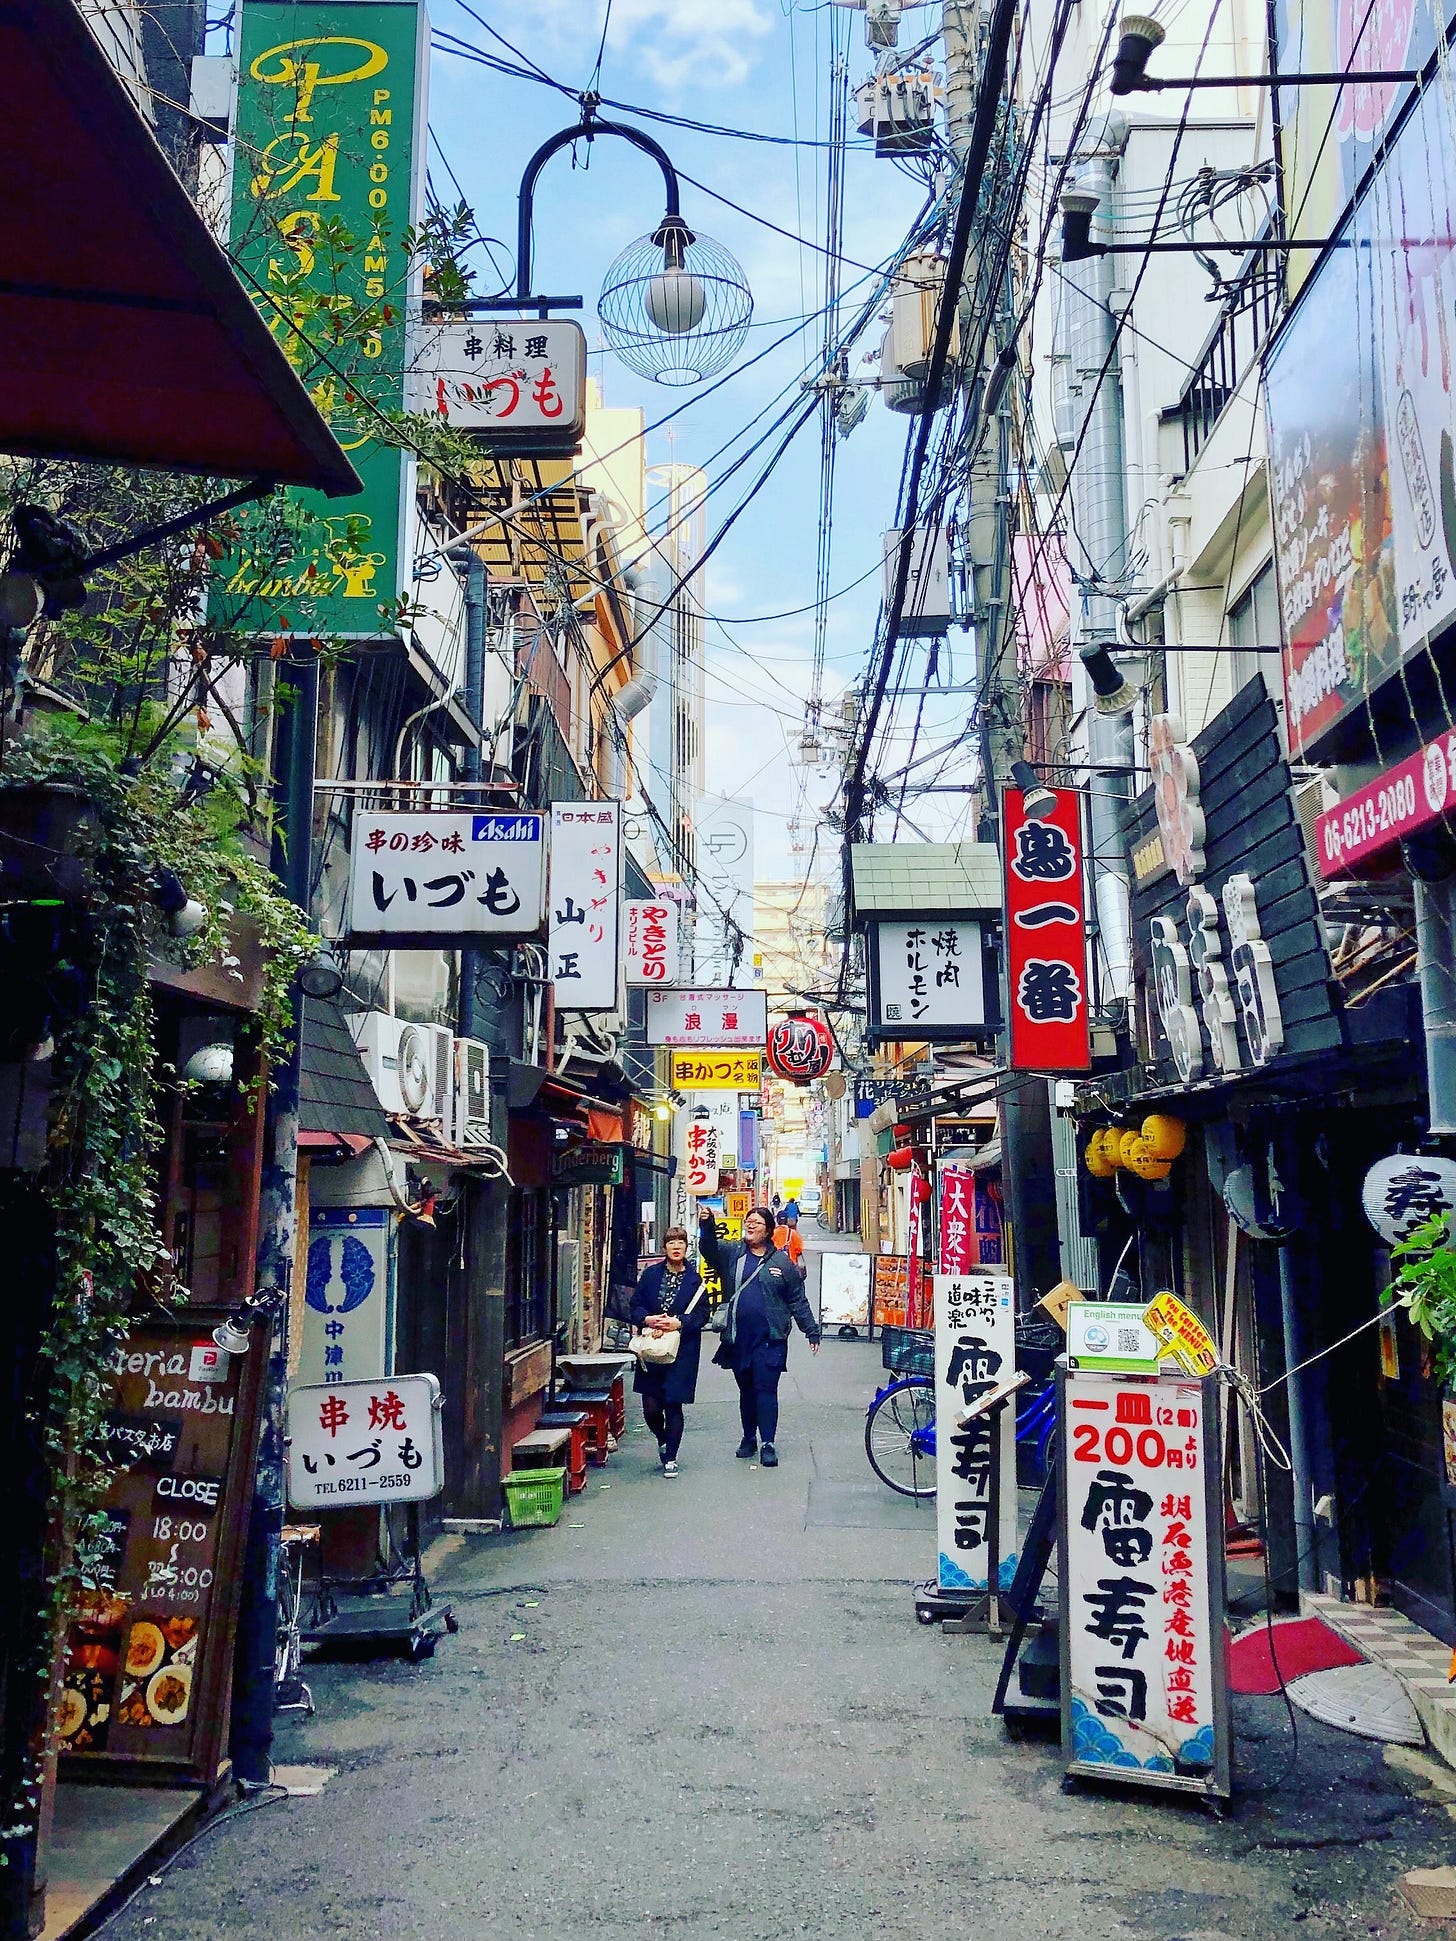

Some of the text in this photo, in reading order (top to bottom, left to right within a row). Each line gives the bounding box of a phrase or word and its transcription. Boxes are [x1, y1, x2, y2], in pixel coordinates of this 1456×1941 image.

[463, 335, 549, 361] 串料理
[436, 367, 566, 420] いづも
[477, 817, 535, 841] Asahi
[561, 811, 614, 825] 日本盛
[364, 829, 466, 855] 串の珍味
[372, 866, 521, 917] いづも
[555, 896, 585, 980] 山正
[628, 907, 639, 956] キリンビール
[642, 906, 669, 980] やきとり
[906, 928, 930, 1019] ホルモン
[931, 927, 962, 989] 焼肉
[652, 992, 668, 1003] 3F
[685, 1012, 738, 1030] 浪漫
[675, 1060, 732, 1082] 串かつ
[732, 1059, 759, 1070] 大阪
[733, 1071, 759, 1083] 名物
[857, 1081, 875, 1099] 花
[687, 1124, 708, 1186] 串かつ
[705, 1126, 718, 1170] 大阪名物
[947, 1283, 968, 1330] 道楽
[962, 1287, 983, 1318] 味の
[979, 1280, 998, 1328] こだわり
[1083, 1309, 1117, 1321] English
[1164, 1310, 1178, 1327] The
[1165, 1297, 1180, 1314] You
[143, 1378, 235, 1415] bambu
[1072, 1392, 1198, 1430] 一皿 (2個)
[318, 1391, 407, 1438] 串焼
[302, 1437, 423, 1474] いづも
[156, 1476, 220, 1507] CLOSE
[315, 1474, 412, 1495] TEL 6211-2559
[153, 1515, 207, 1542] 18:00
[1081, 1469, 1159, 1722] 雷寿司
[1159, 1493, 1200, 1726] 明石漁港産地直送
